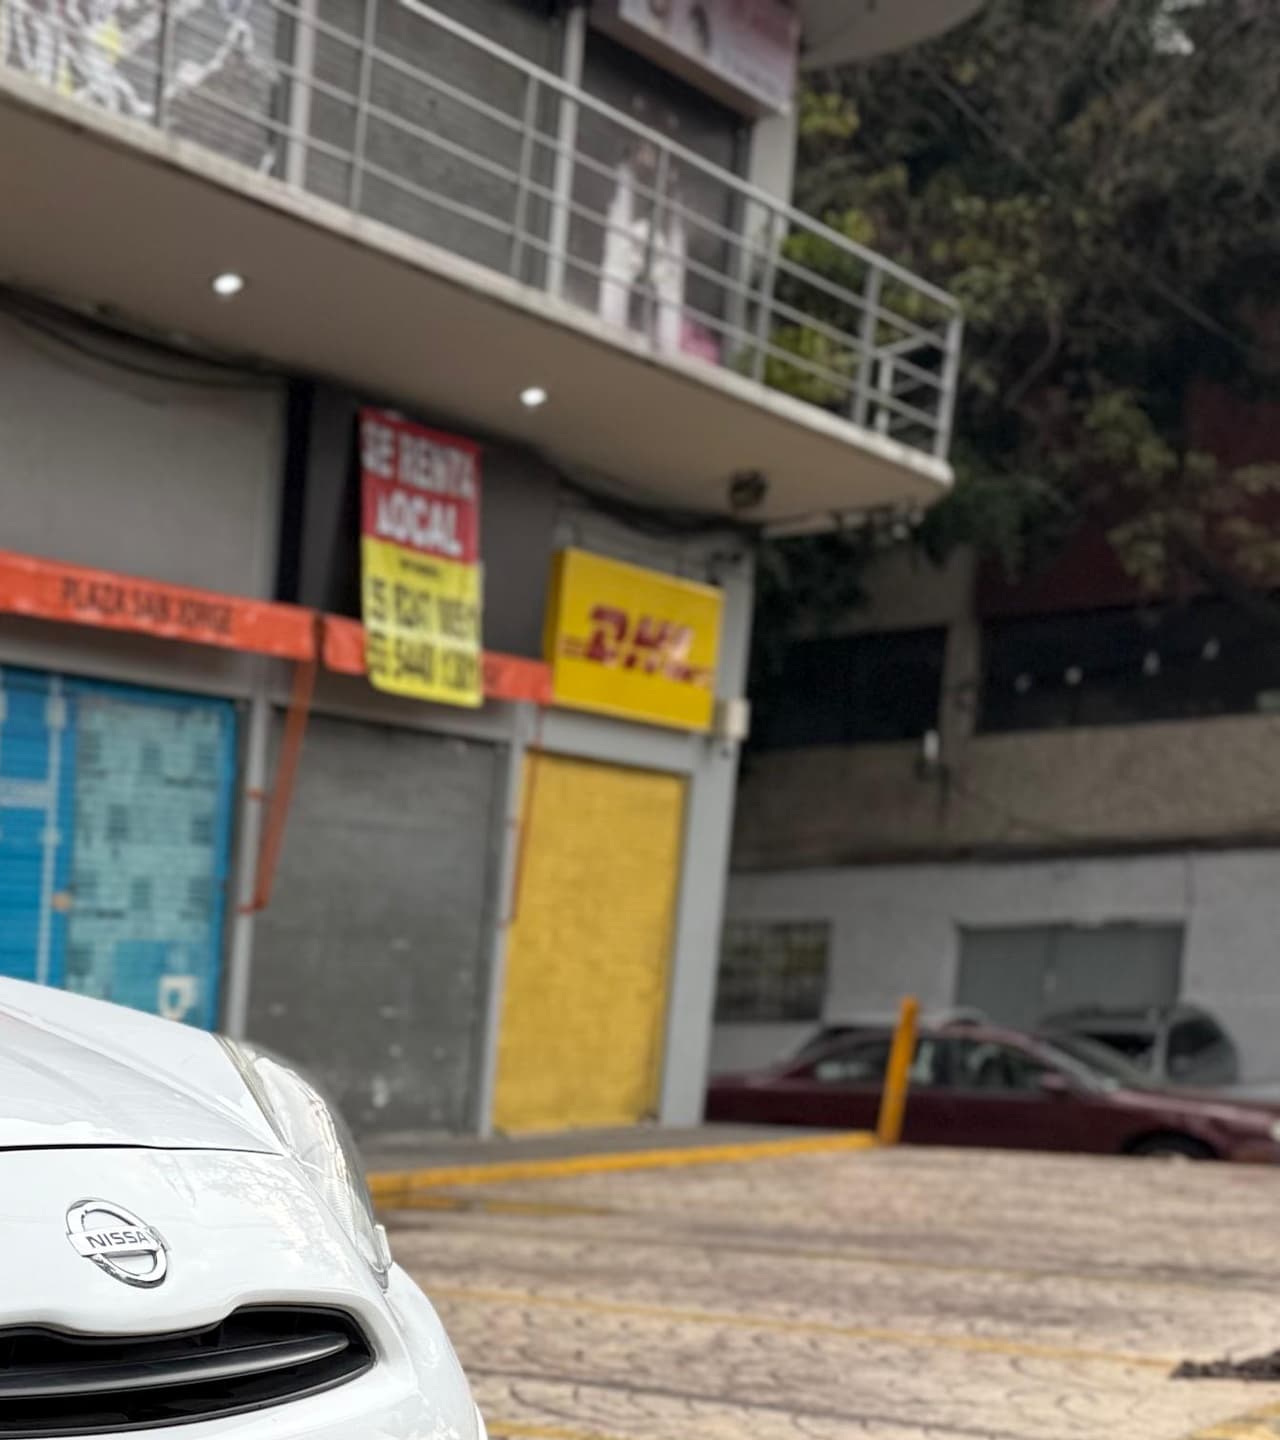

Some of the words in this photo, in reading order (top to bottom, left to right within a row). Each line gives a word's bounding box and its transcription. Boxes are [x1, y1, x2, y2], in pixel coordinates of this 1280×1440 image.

[375, 488, 463, 556] LOCAL
[61, 577, 126, 615] PLAZA
[586, 604, 696, 675] DHL
[85, 1230, 157, 1249] NISSA
